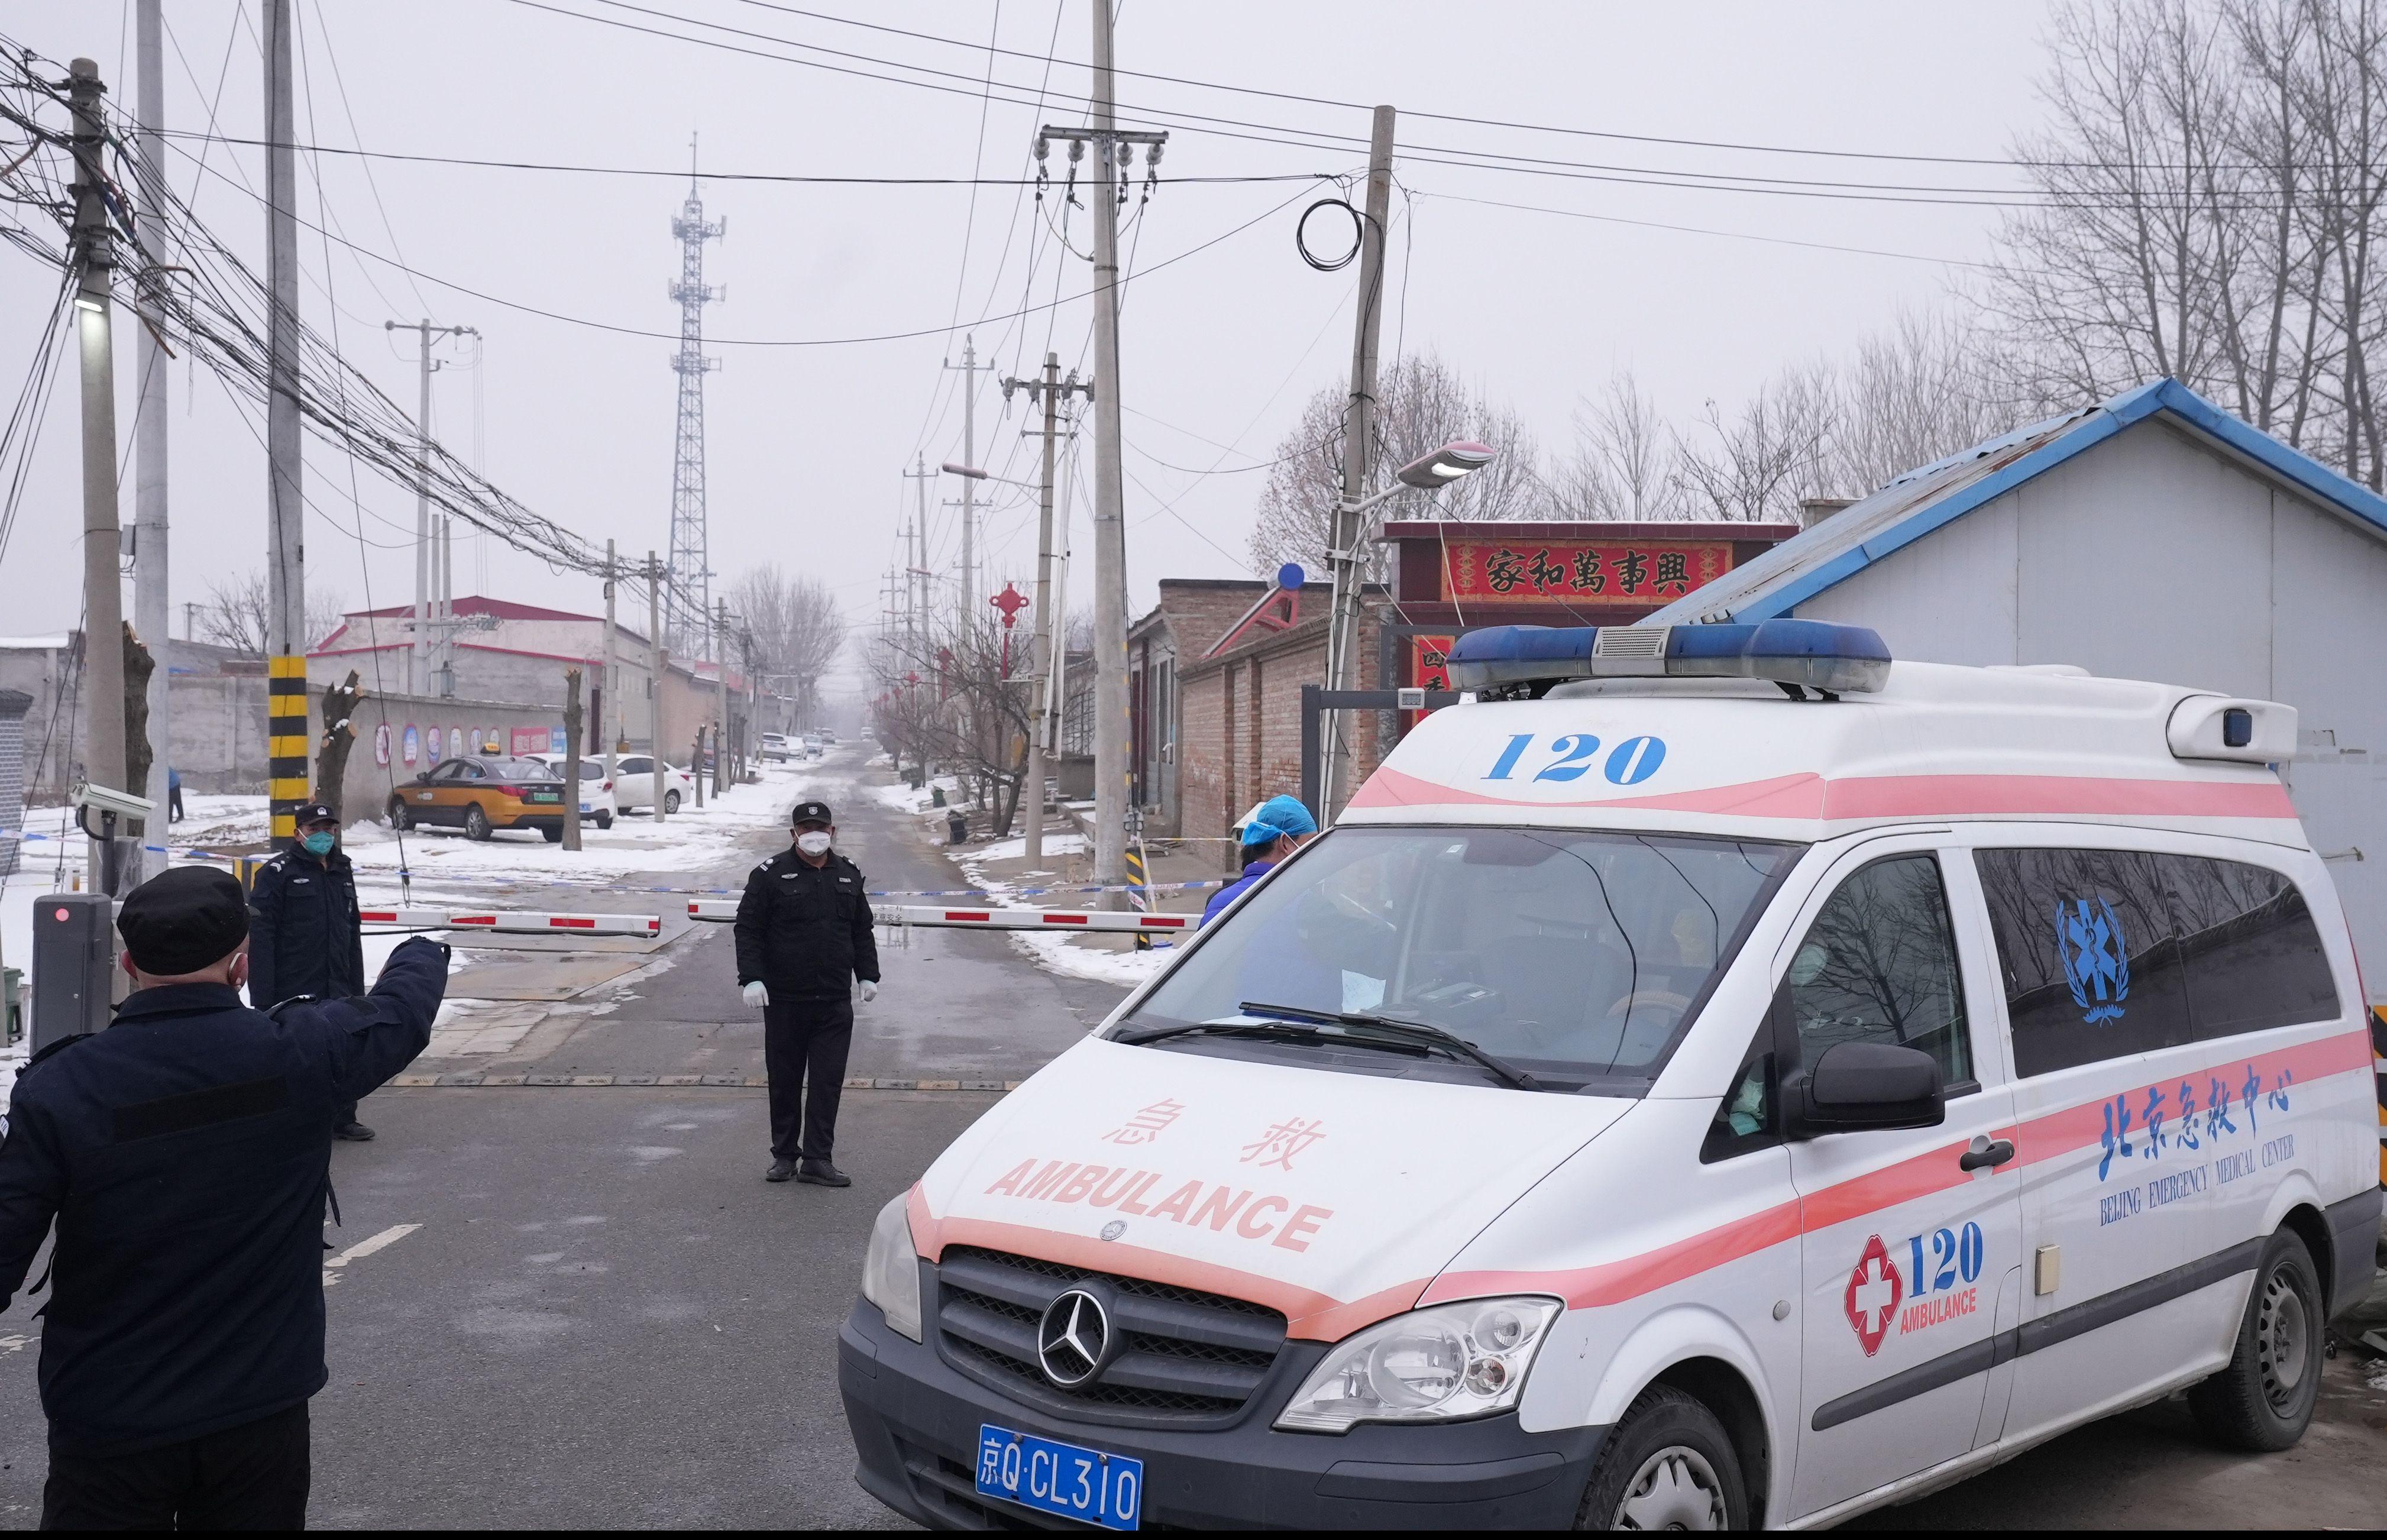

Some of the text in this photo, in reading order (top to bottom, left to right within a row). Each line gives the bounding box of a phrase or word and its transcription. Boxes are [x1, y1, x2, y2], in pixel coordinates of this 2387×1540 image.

[1486, 549, 1690, 594] 家和萬事興
[1480, 733, 1666, 785] 120
[2099, 1064, 2292, 1182] 北京急救中心
[983, 1159, 1334, 1253] AMBULANCE
[2100, 1134, 2295, 1227] BEIJING EMERGENCY MEDICAL CENTER
[1908, 1221, 1983, 1299] 120
[1900, 1287, 1977, 1335] AMBULANCE
